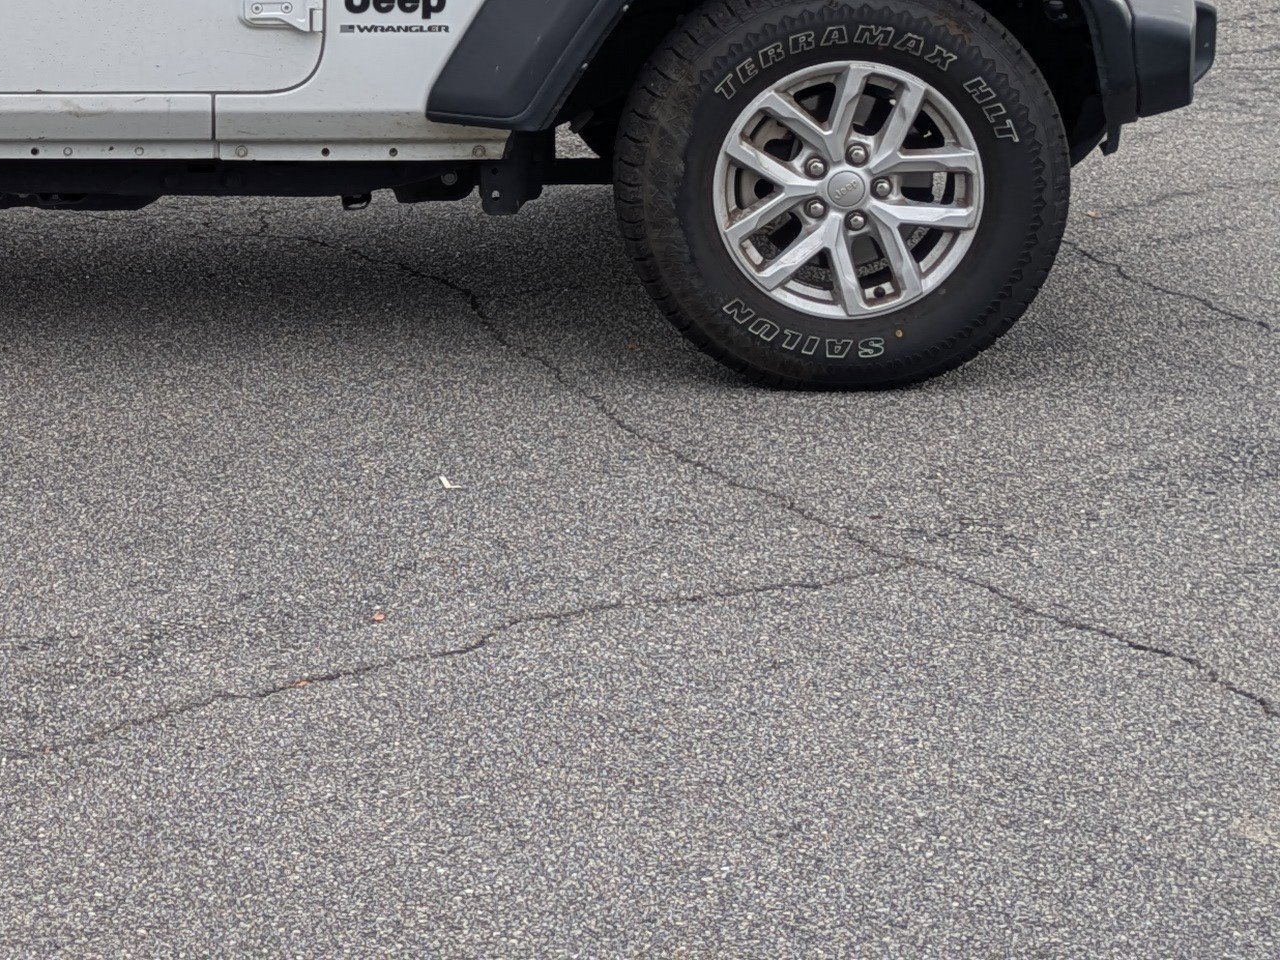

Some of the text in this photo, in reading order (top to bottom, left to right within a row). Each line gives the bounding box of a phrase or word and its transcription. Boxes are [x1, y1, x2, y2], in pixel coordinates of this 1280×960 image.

[356, 24, 449, 33] WRANGLER
[715, 24, 1020, 144] TERRAMAX HLT
[723, 299, 885, 358] SAILUN
